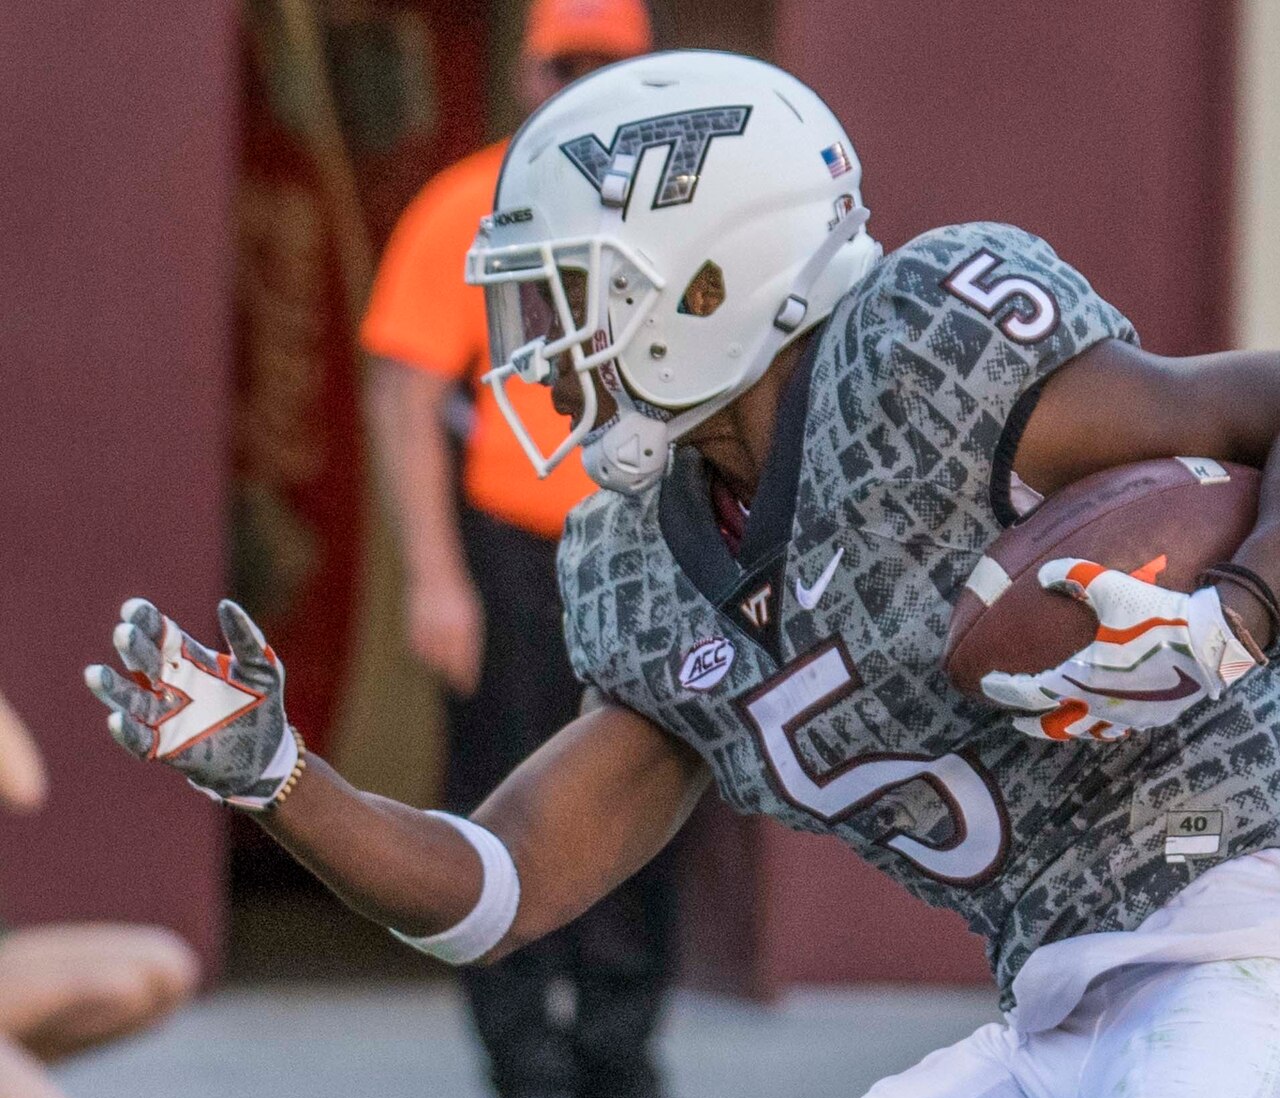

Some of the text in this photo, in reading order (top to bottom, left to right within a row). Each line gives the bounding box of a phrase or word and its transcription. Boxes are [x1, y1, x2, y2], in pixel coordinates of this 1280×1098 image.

[560, 105, 753, 222] VT
[940, 250, 1062, 345] 5
[740, 582, 772, 626] VT
[688, 641, 728, 680] ACC
[742, 632, 1010, 886] 5
[1179, 815, 1208, 832] 40
